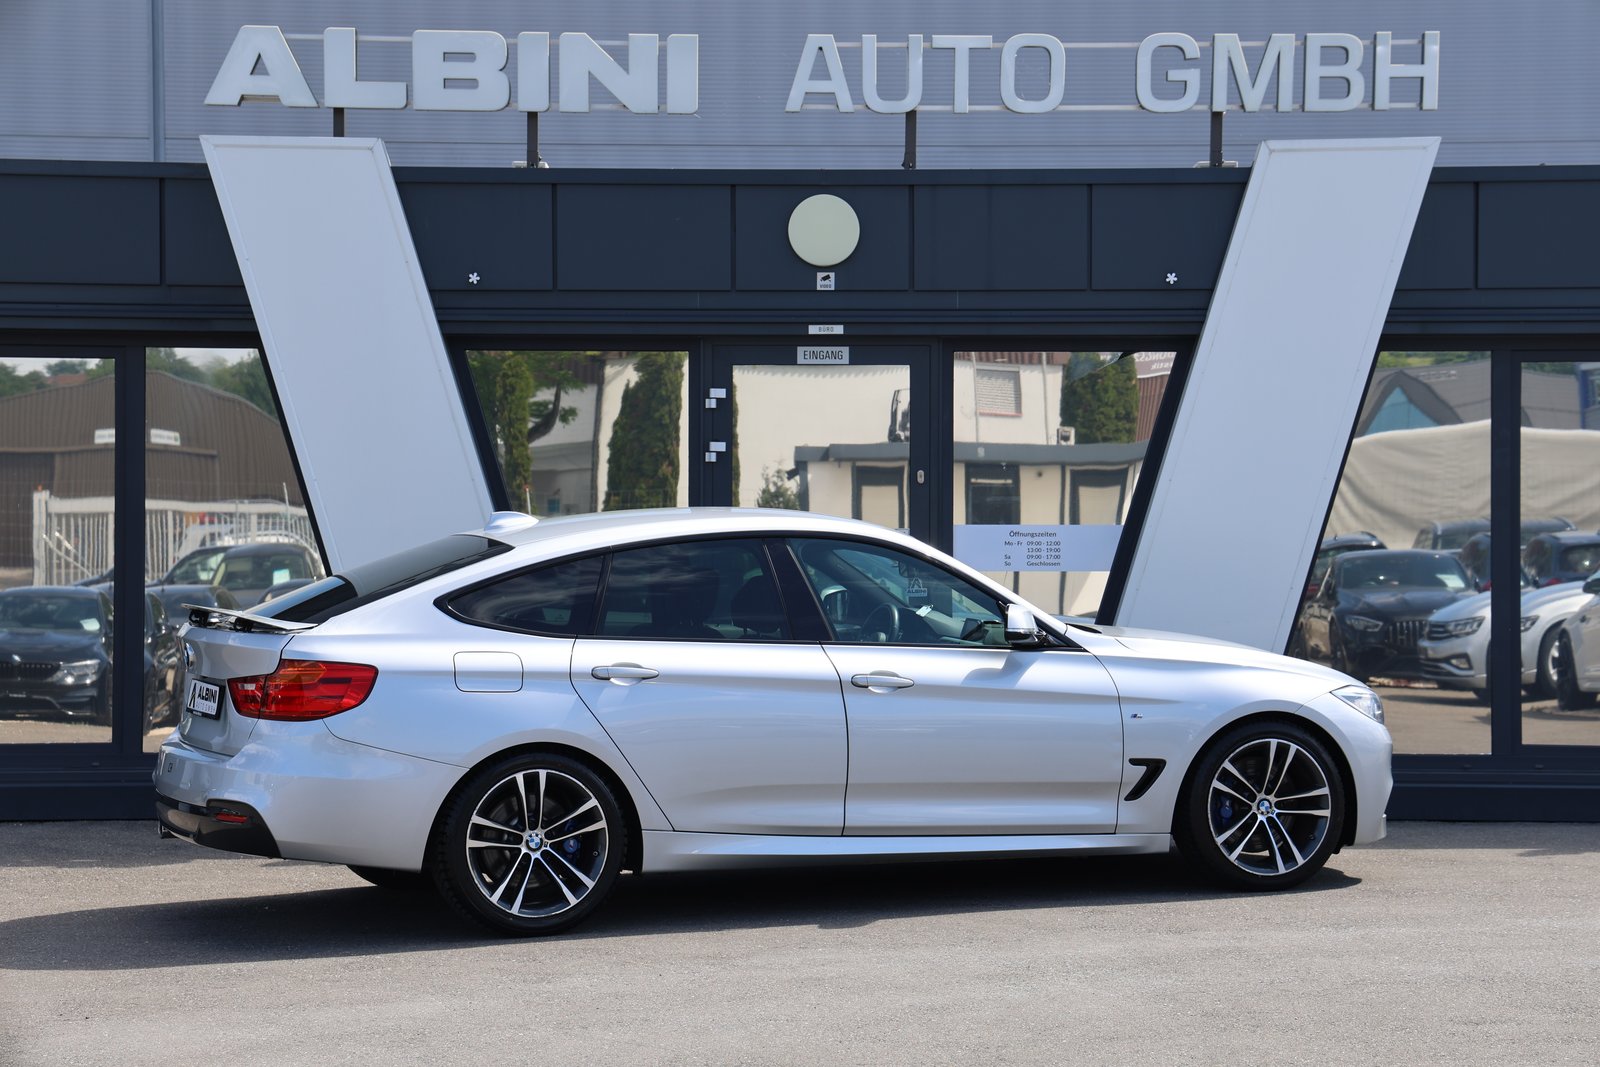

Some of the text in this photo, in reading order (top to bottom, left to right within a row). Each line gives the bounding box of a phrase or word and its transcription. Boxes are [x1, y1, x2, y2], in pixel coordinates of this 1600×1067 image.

[204, 24, 1441, 115] ALBINI AUTO GMBH
[803, 350, 844, 360] EINGANG
[1009, 530, 1056, 538] Öffnungszeiten
[198, 686, 217, 704] ALBINI
